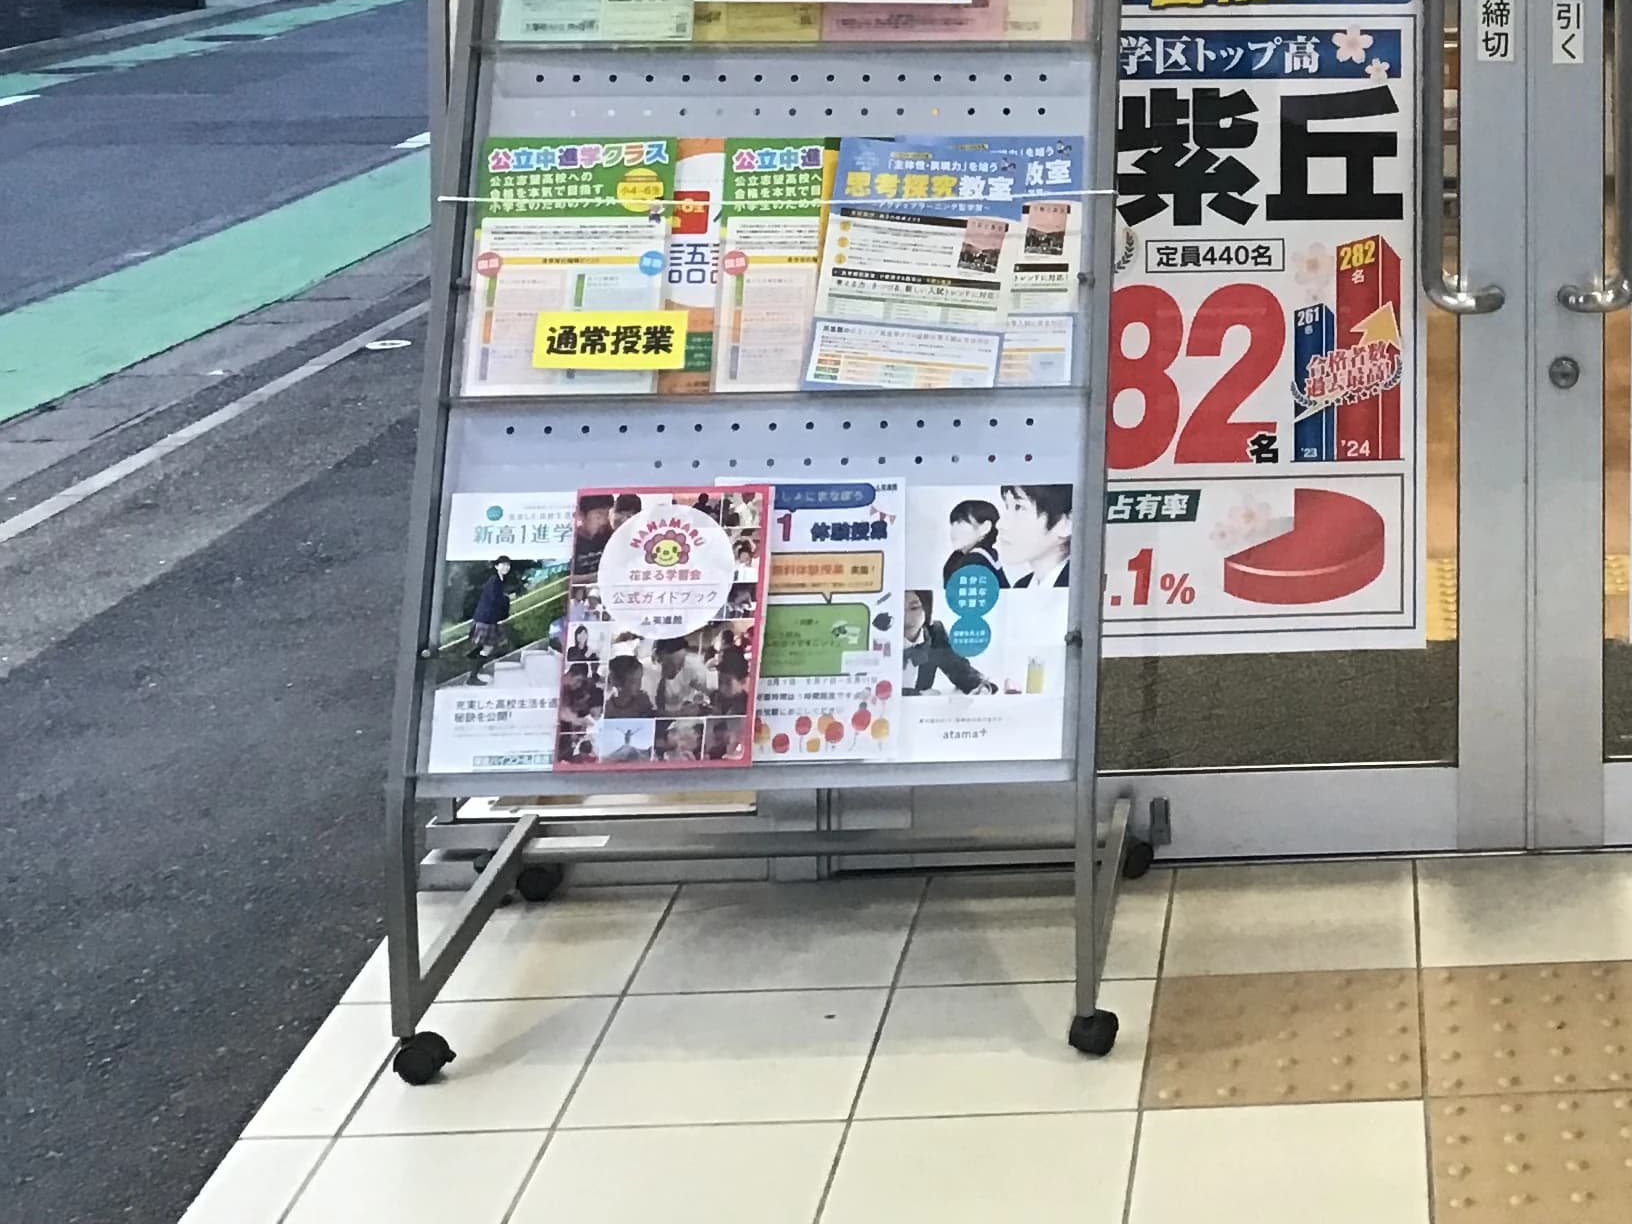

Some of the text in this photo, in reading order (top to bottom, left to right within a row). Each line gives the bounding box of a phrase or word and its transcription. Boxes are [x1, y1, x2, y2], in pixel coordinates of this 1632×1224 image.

[1557, 3, 1580, 59] 引く
[1120, 35, 1320, 75] 学区トップ高
[488, 141, 669, 173] 公立中進学クラス
[733, 146, 822, 172] 公立中進
[1116, 85, 1403, 226] 紫丘
[1156, 244, 1273, 267] 定員440名
[1339, 240, 1376, 271] 282
[1297, 306, 1320, 326] 261
[546, 325, 675, 356] 通常授業
[1307, 341, 1390, 377] 合格者数
[1106, 492, 1189, 519] 占有率
[630, 518, 704, 548] HANAMARU
[629, 569, 701, 581] 花まる学習会
[613, 591, 717, 605] 公式ガイドブック
